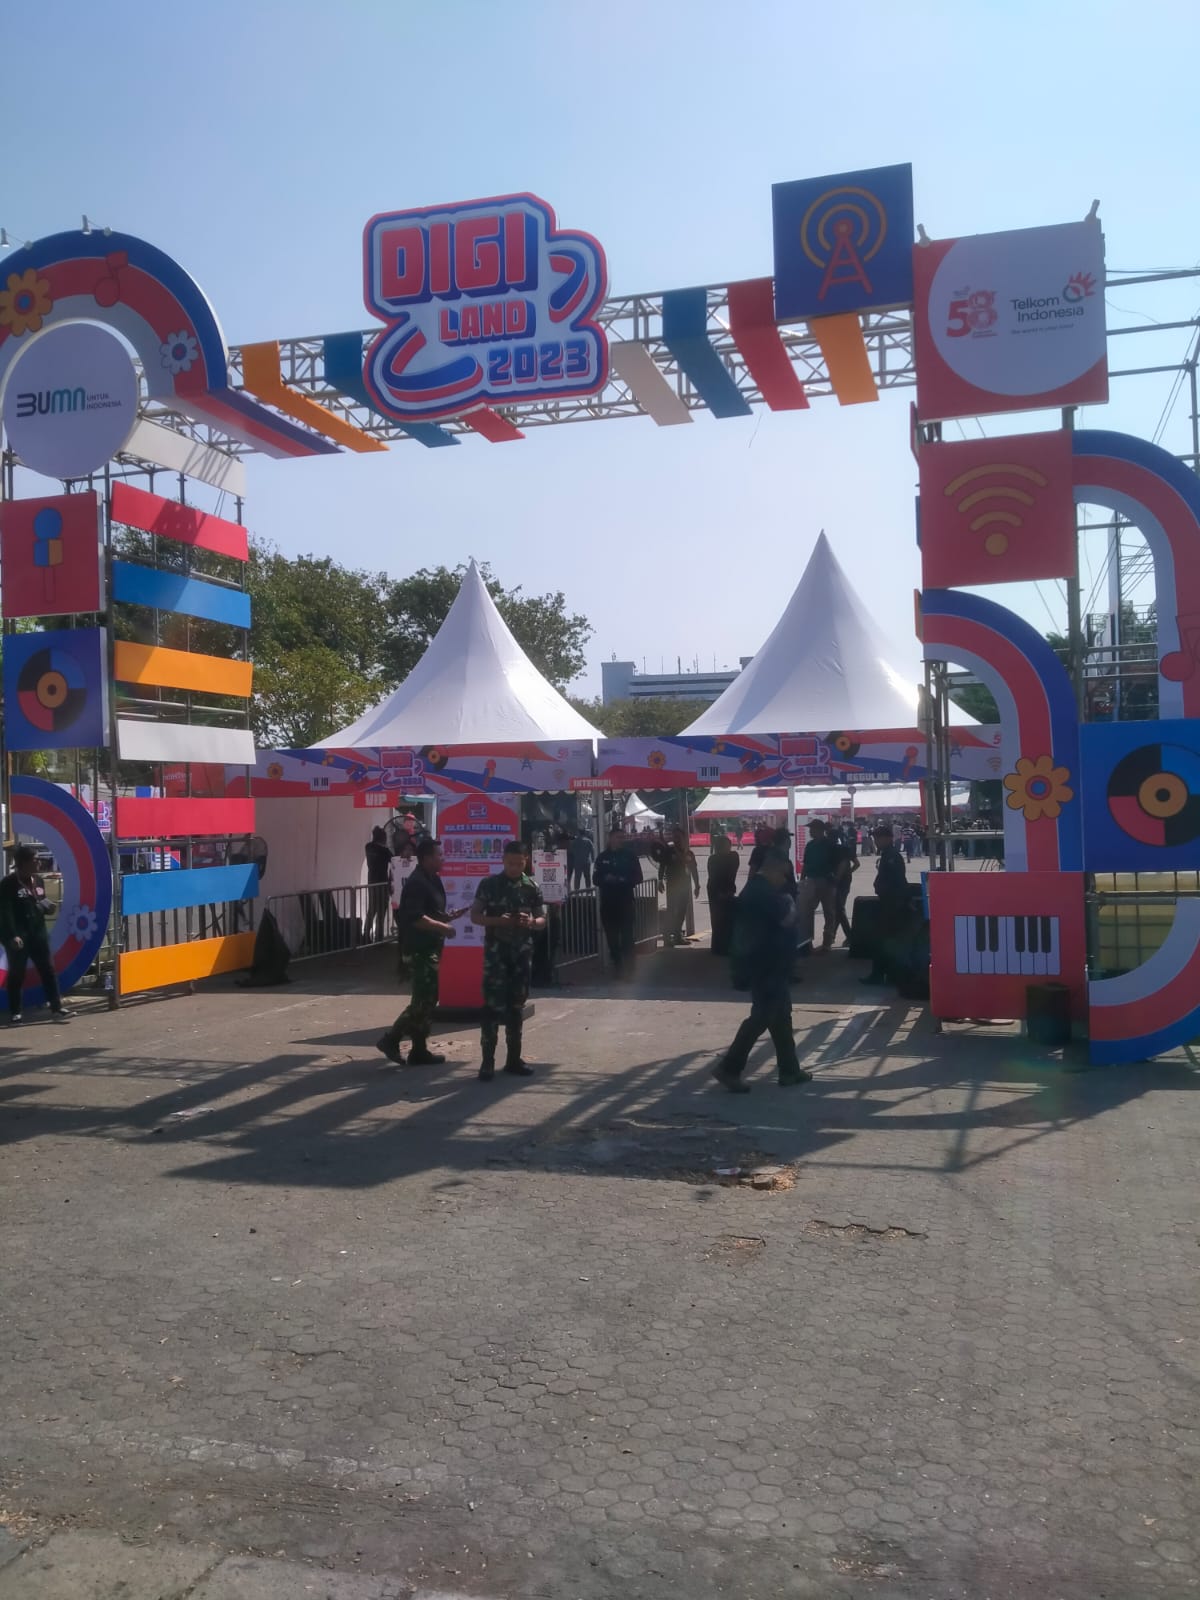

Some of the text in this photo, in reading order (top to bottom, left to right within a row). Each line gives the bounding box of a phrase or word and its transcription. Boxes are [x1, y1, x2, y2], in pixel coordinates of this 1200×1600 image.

[380, 211, 538, 305] DIGI
[1010, 296, 1060, 311] Telkom
[946, 289, 998, 337] 58
[1017, 306, 1084, 323] Indonesia
[439, 300, 536, 347] LAND
[487, 339, 591, 387] 2023
[86, 393, 110, 401] UNTUK
[86, 400, 122, 409] INDONESIA
[573, 778, 614, 788] INTERNAL
[846, 772, 890, 781] REGULAR
[365, 792, 388, 807] VIP
